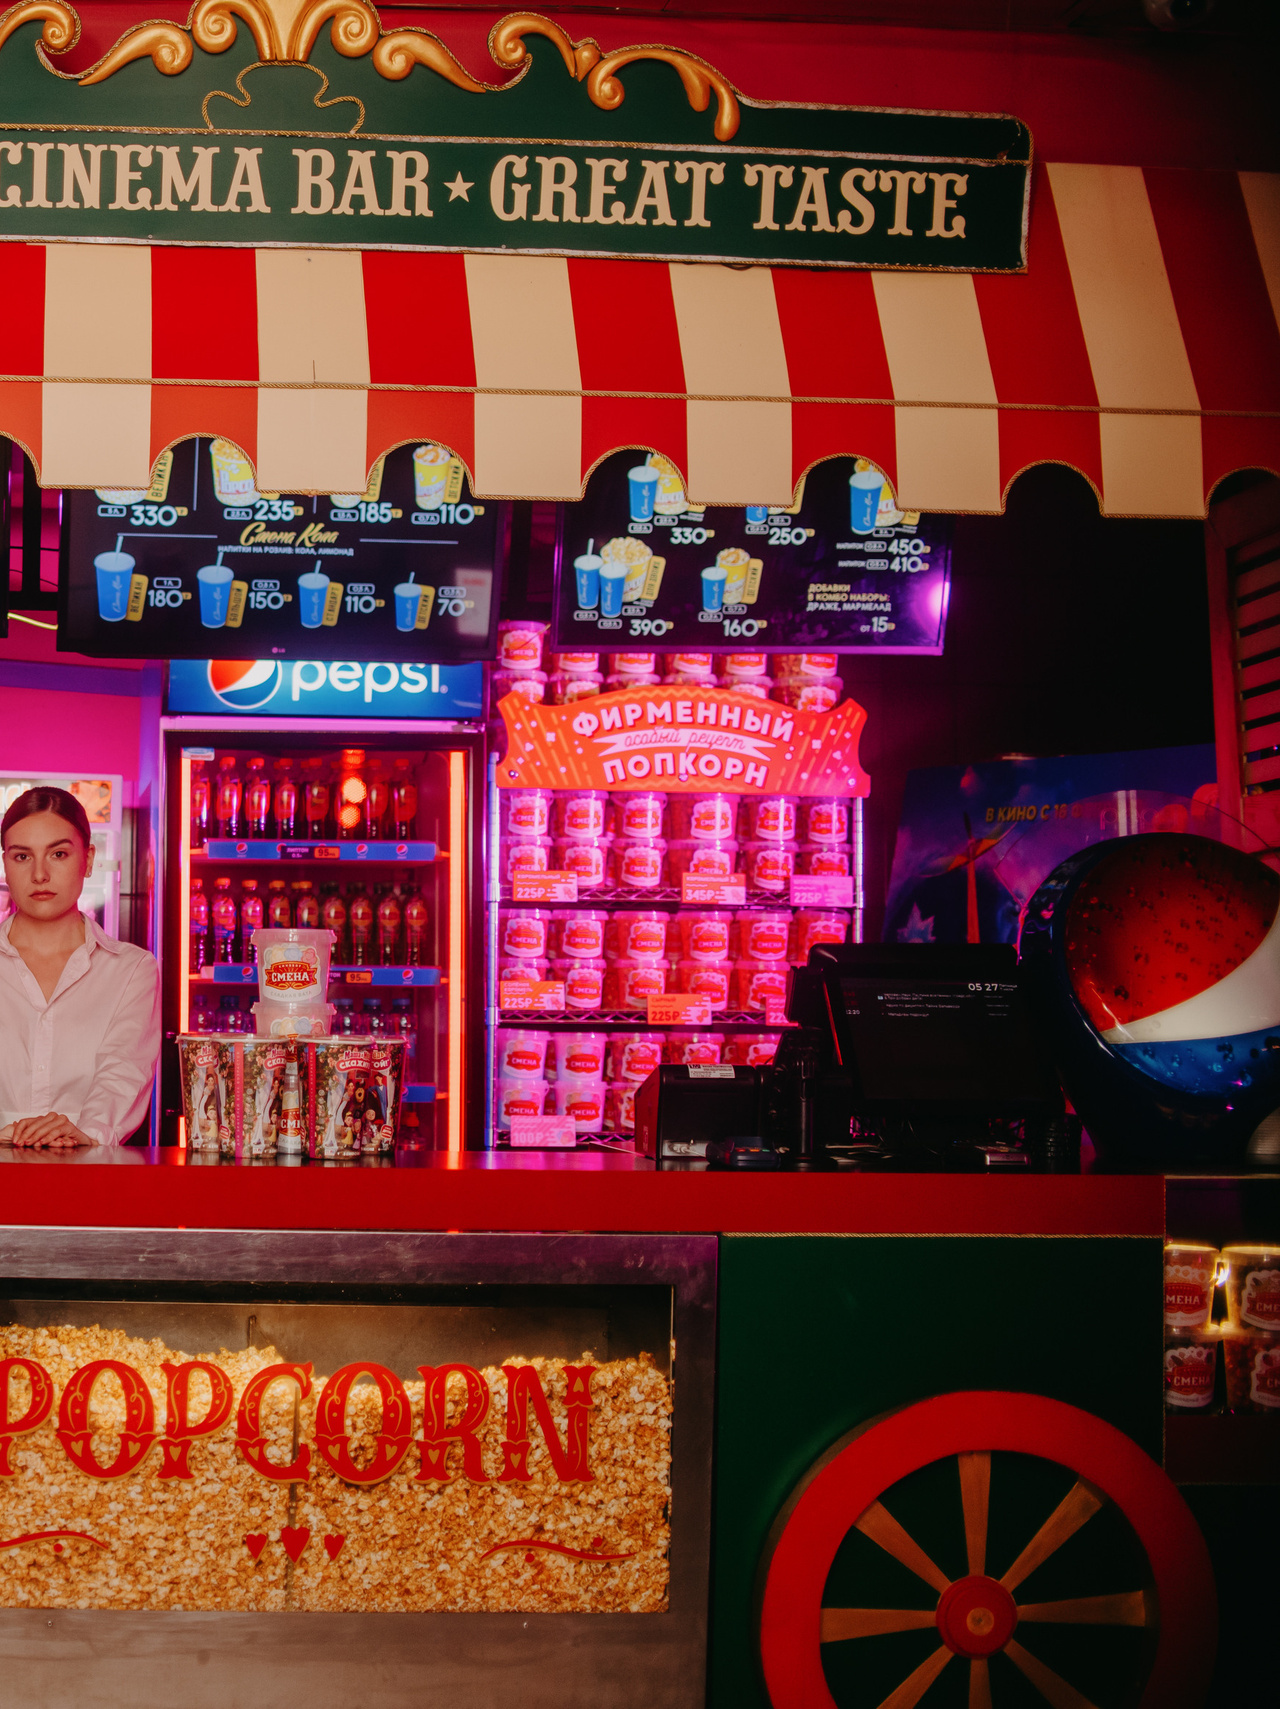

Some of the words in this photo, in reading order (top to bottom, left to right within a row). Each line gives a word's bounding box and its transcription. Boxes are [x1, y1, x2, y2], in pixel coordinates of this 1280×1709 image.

[290, 147, 433, 217] BAR
[490, 153, 726, 229] GREAT
[744, 162, 969, 240] TASTE
[130, 505, 179, 526] 330
[254, 500, 296, 522] 235
[358, 502, 393, 524] 185
[439, 503, 475, 525] 110
[670, 527, 707, 545] 330
[768, 527, 807, 545] 250
[888, 538, 924, 556] 450
[890, 556, 923, 573] 410
[808, 583, 851, 593] ДОБАВКИ
[148, 589, 184, 608] 180
[248, 592, 284, 610] 150
[345, 595, 376, 614] 110
[437, 599, 466, 617] 70
[629, 618, 667, 636] 390
[722, 618, 759, 637] 160
[871, 616, 888, 633] 15
[292, 660, 439, 703] pepsi
[572, 700, 794, 743] ФИРМЕННЫЙ
[603, 752, 768, 788] ПОПКОРН
[986, 809, 995, 823] В
[997, 805, 1037, 822] КИНО
[271, 971, 310, 982] СМЕНА
[1174, 1376, 1210, 1386] СМЕНА
